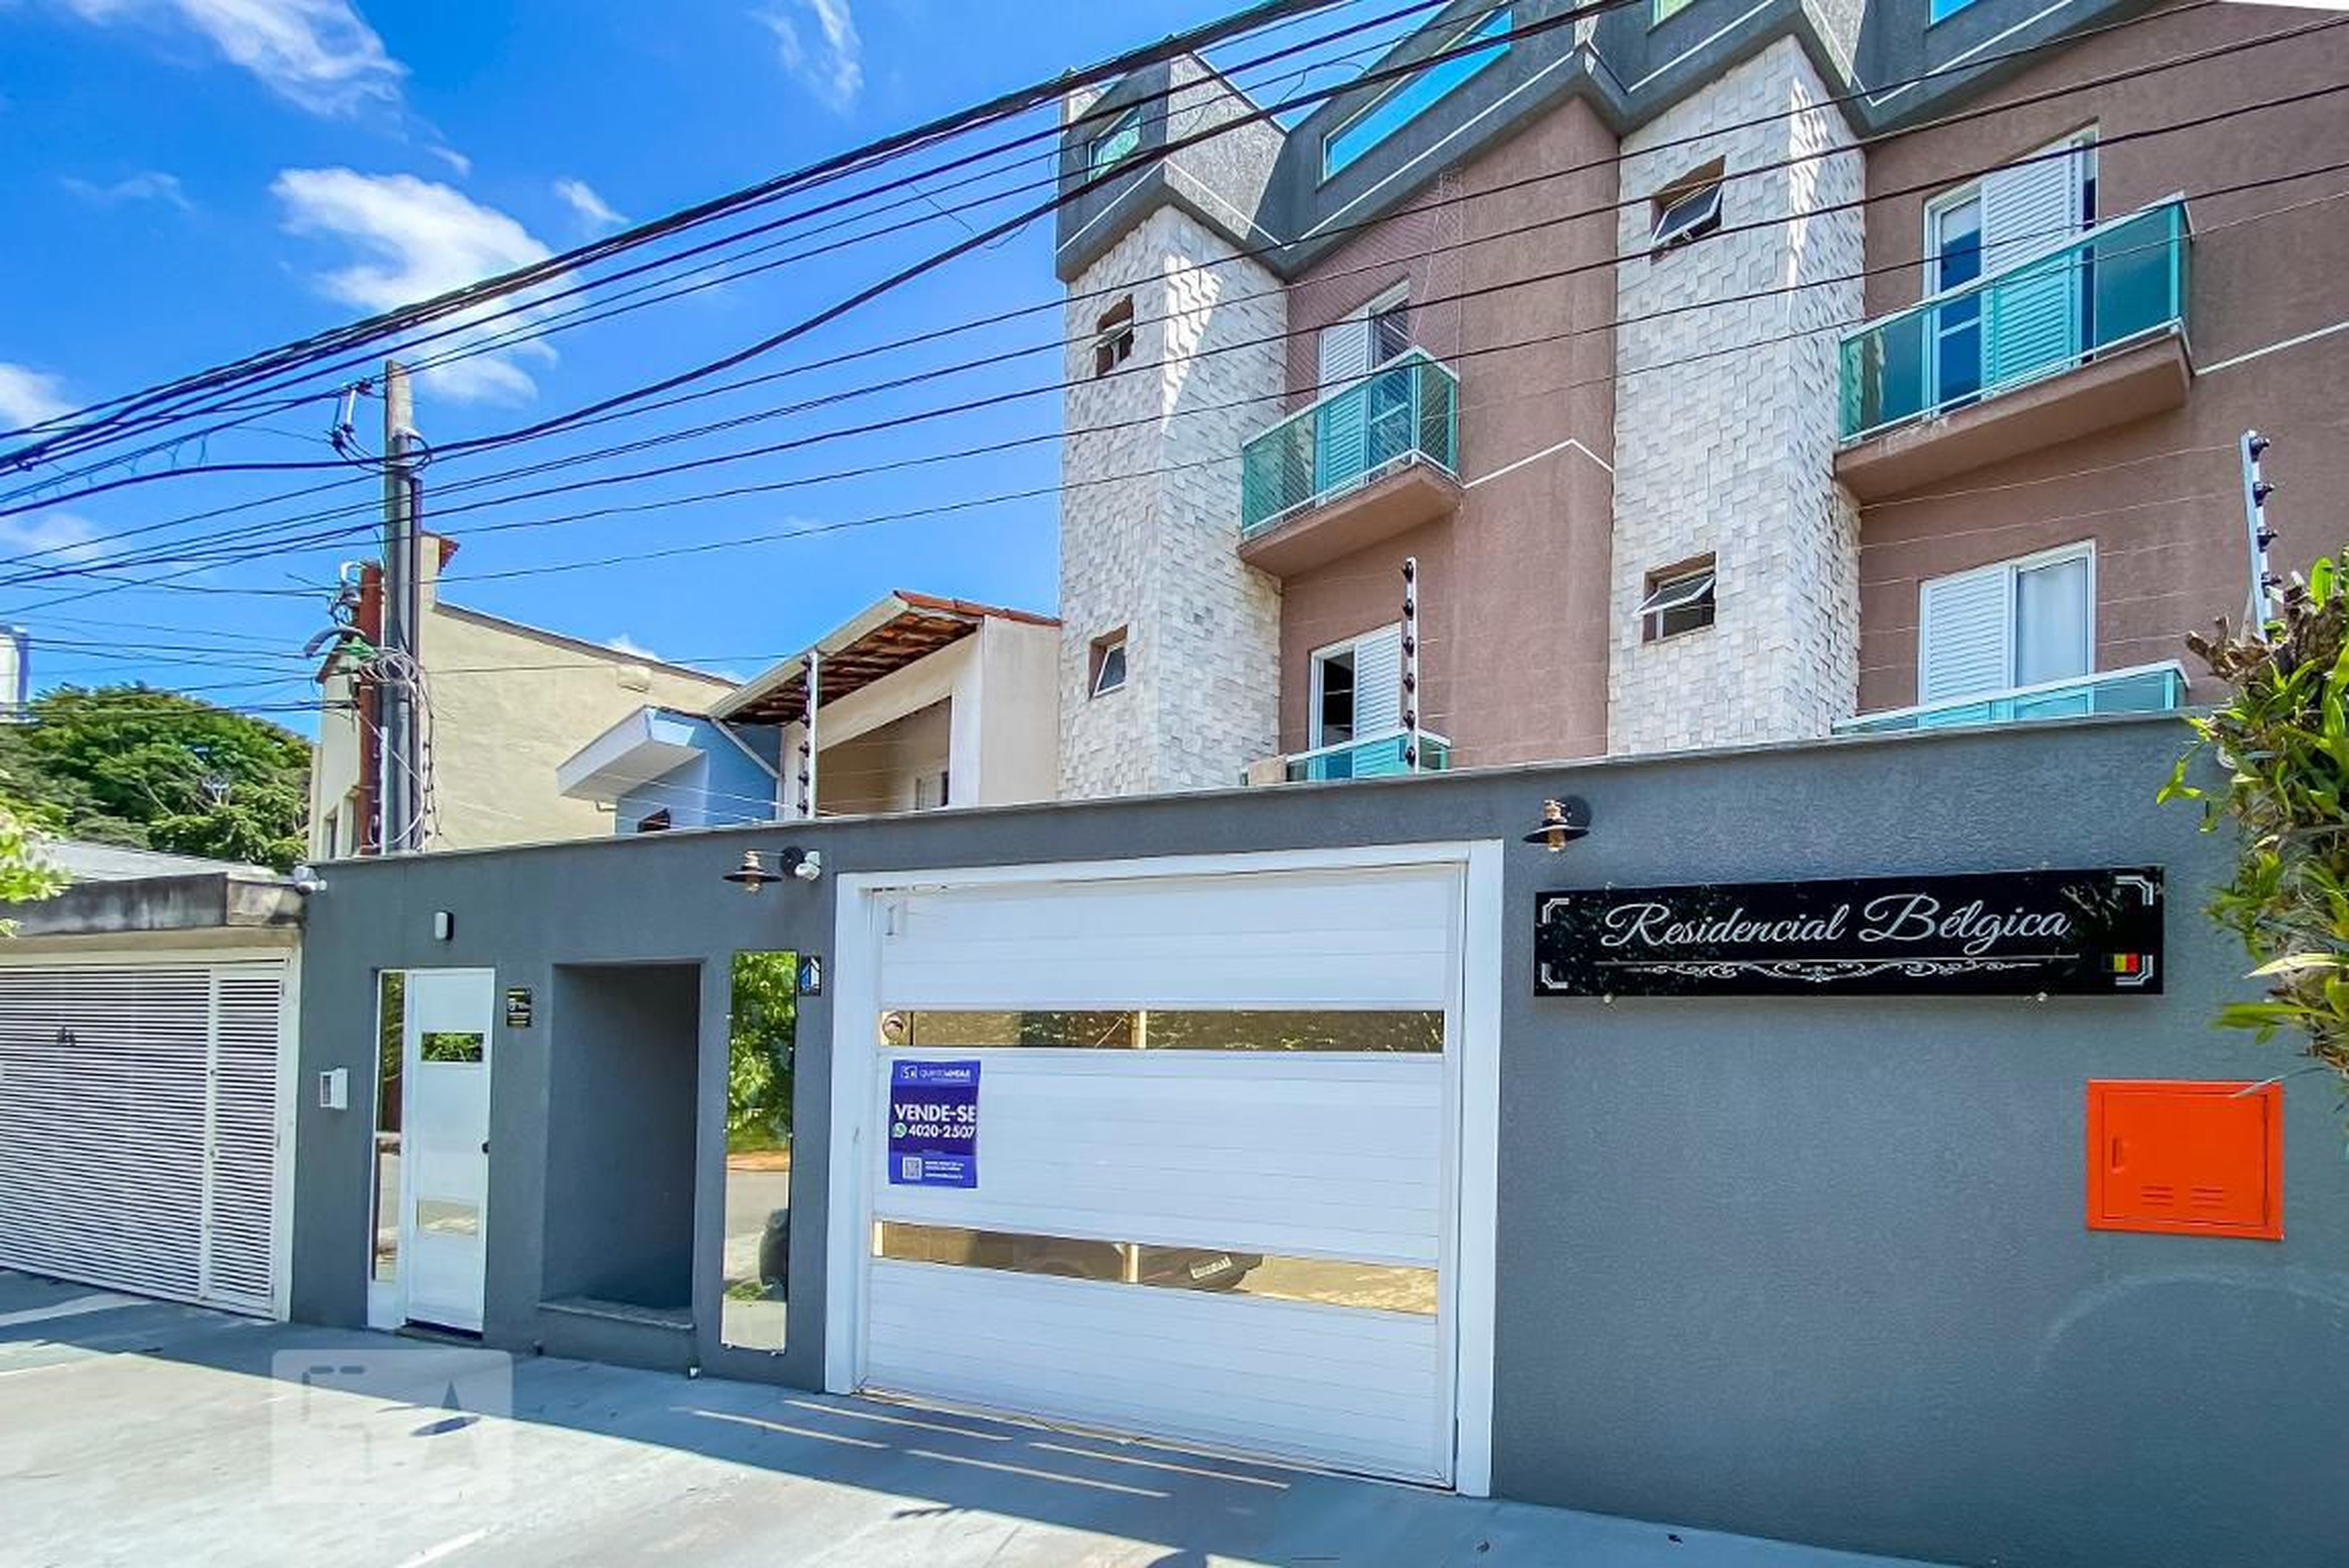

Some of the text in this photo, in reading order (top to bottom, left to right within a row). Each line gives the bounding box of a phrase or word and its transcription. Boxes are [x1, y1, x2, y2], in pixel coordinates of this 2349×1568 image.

[1600, 892, 2072, 956] Residencial Bélgica
[894, 1103, 976, 1123] VENDE-SE
